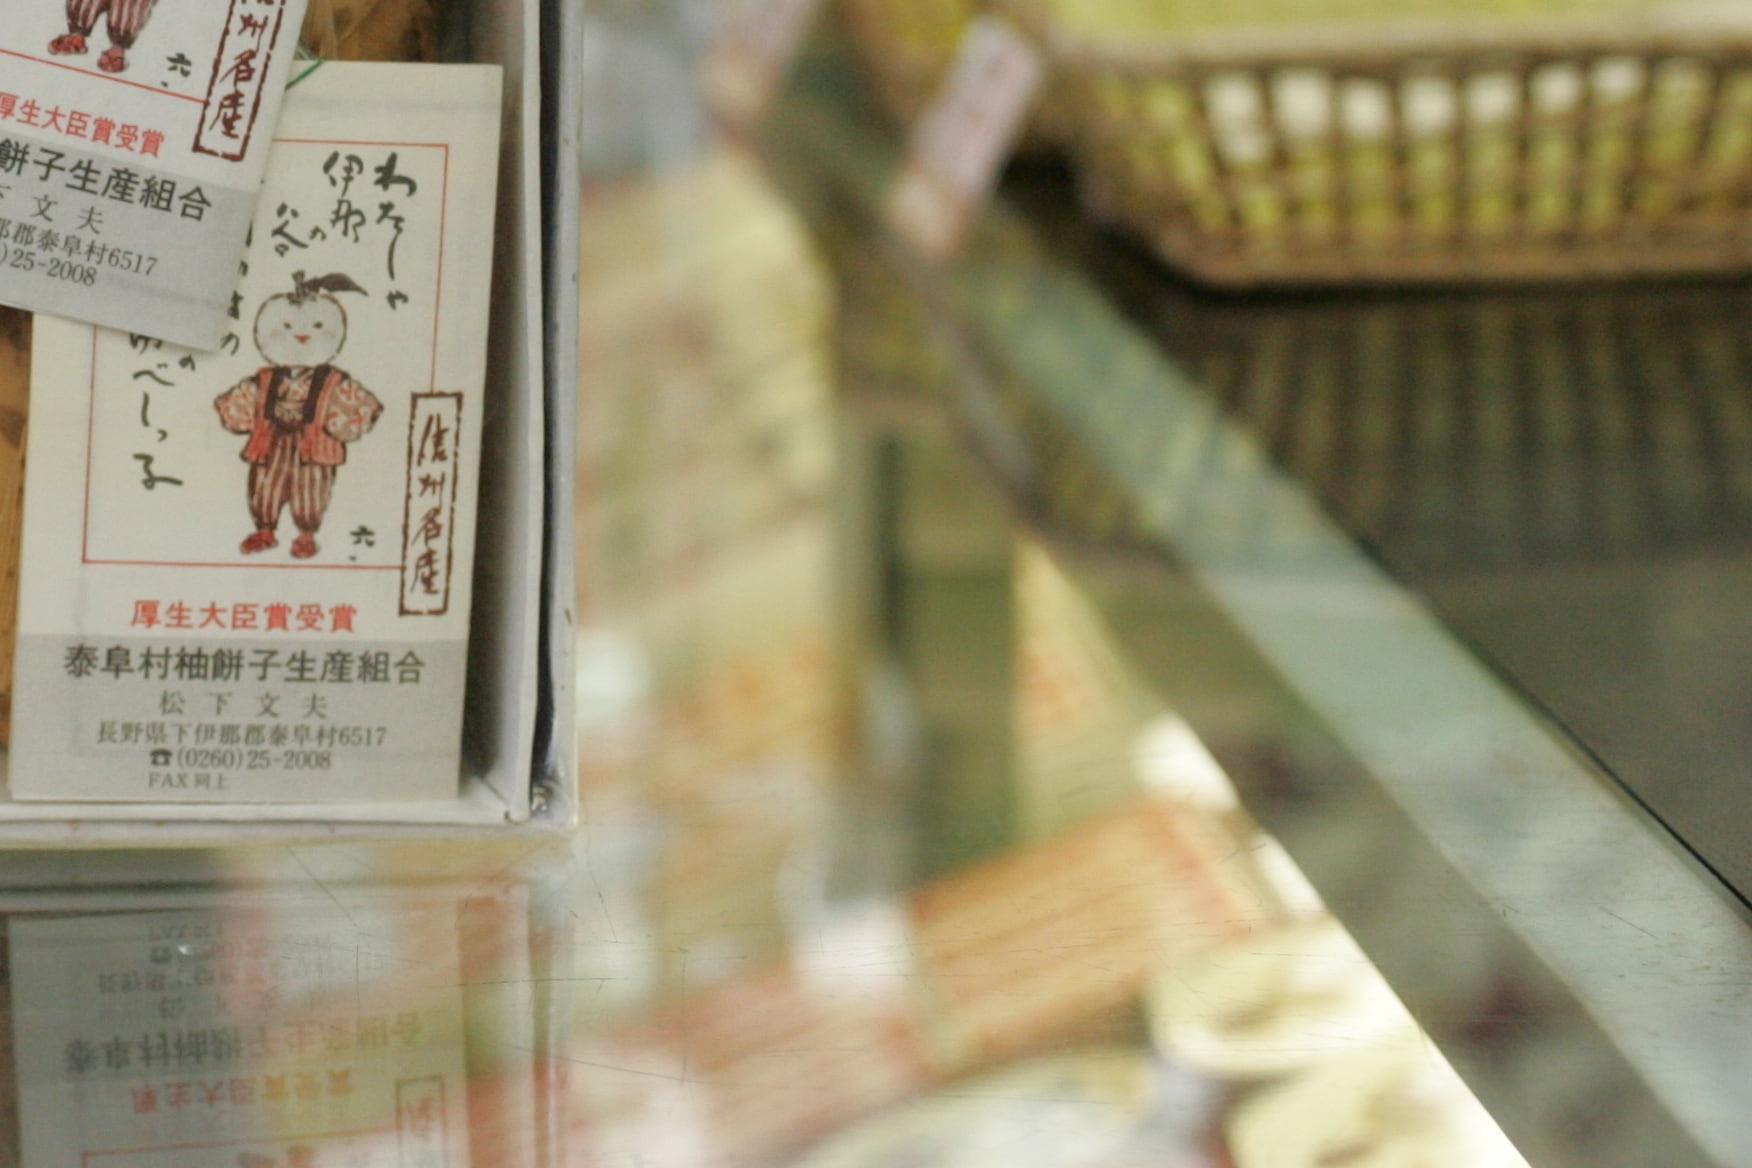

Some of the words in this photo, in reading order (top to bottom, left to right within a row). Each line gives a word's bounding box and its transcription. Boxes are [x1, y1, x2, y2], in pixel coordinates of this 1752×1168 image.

[130, 599, 359, 633] 厚生大臣賞受賞
[63, 643, 427, 685] 泰阜村柚餅子生産組合
